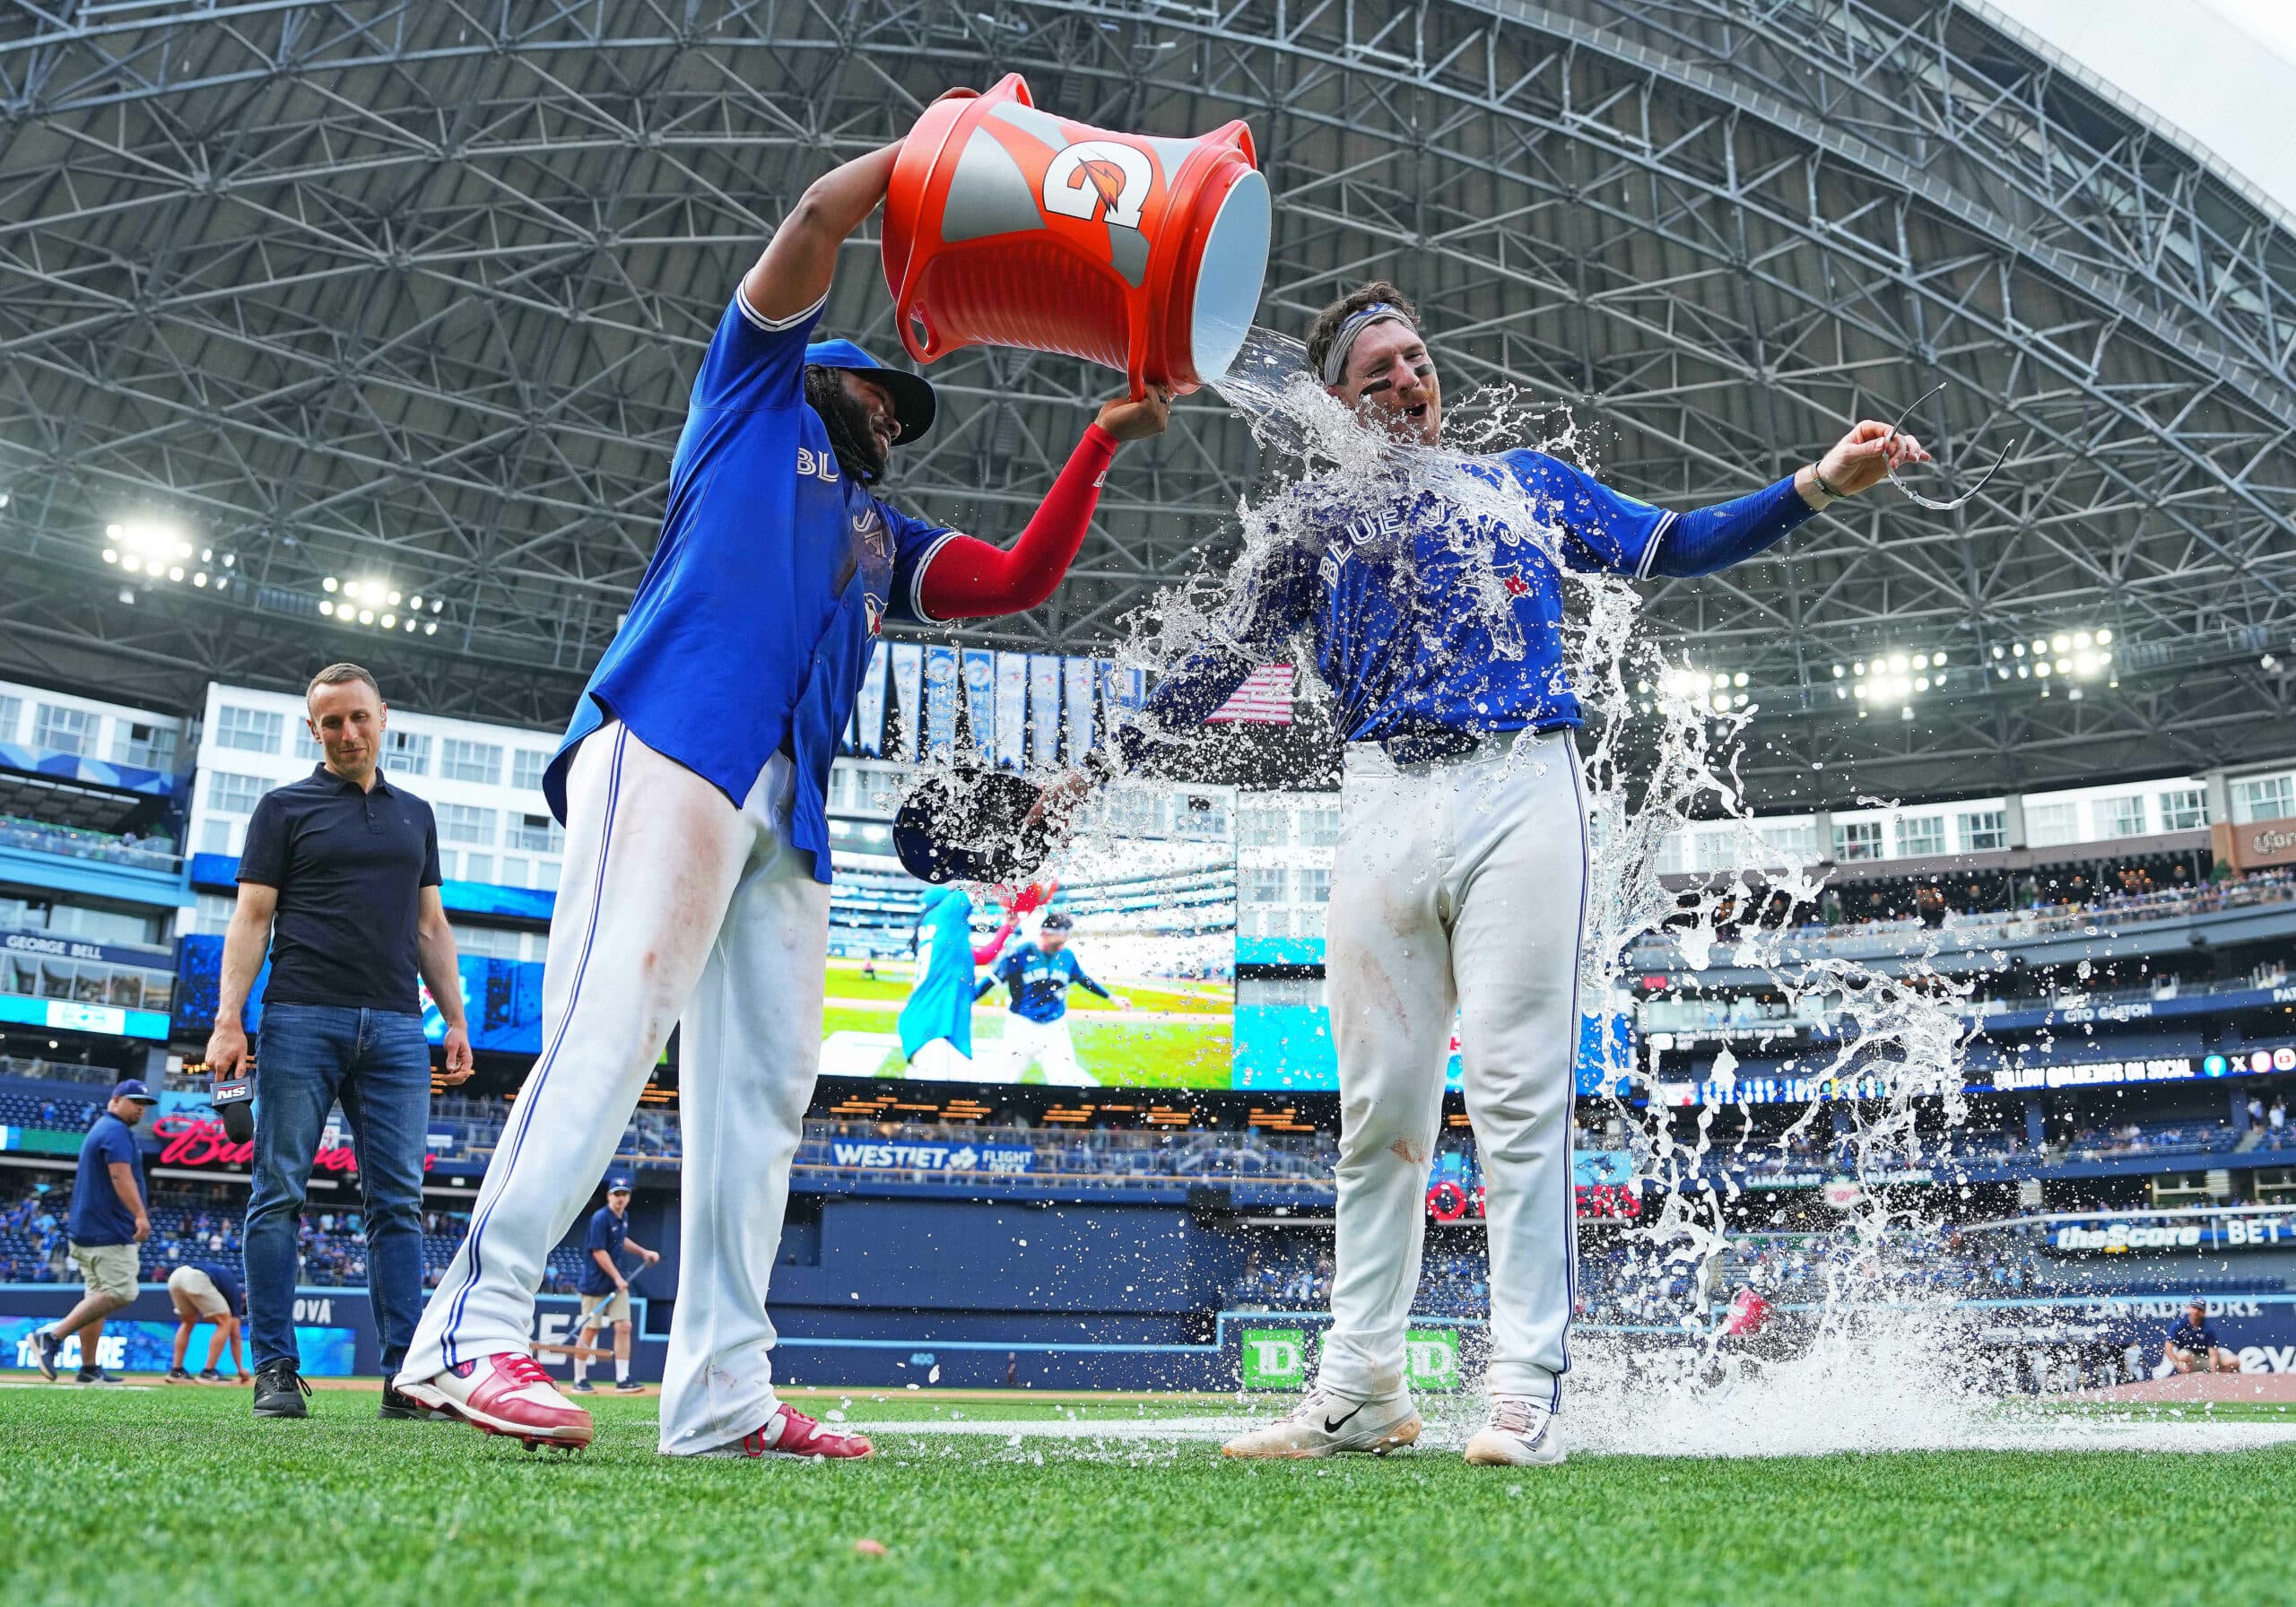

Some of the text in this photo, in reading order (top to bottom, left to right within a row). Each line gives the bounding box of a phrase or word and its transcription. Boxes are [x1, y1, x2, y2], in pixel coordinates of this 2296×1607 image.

[1042, 140, 1153, 230] G
[796, 447, 839, 483] BL
[852, 508, 891, 560] JA
[1318, 508, 1406, 589] BLUE
[5, 935, 103, 960] GEORGE BELL
[982, 1150, 1033, 1164] FLIGHT
[2057, 1219, 2282, 1249] theScore BET
